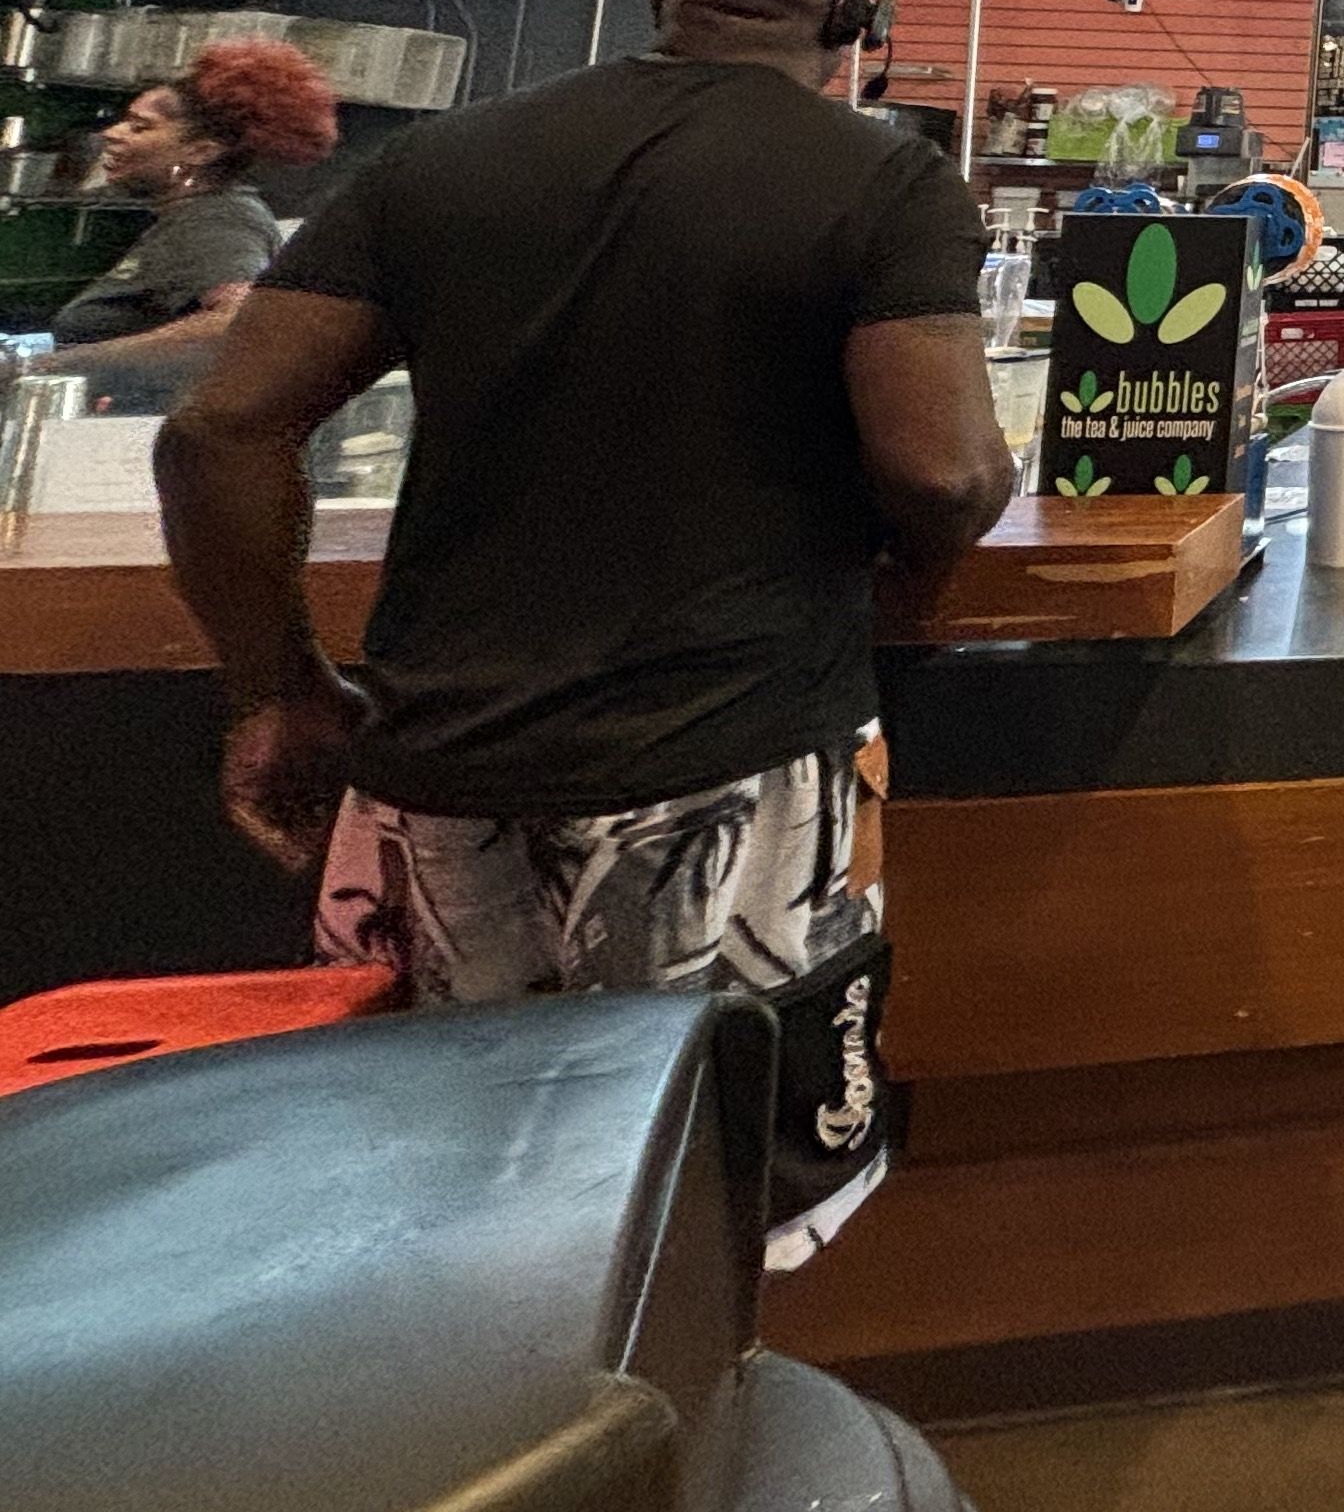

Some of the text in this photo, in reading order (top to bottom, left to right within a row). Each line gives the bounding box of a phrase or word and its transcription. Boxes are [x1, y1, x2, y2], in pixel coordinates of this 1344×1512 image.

[1116, 370, 1220, 414] bubbles
[1060, 415, 1216, 442] the tea & juice company
